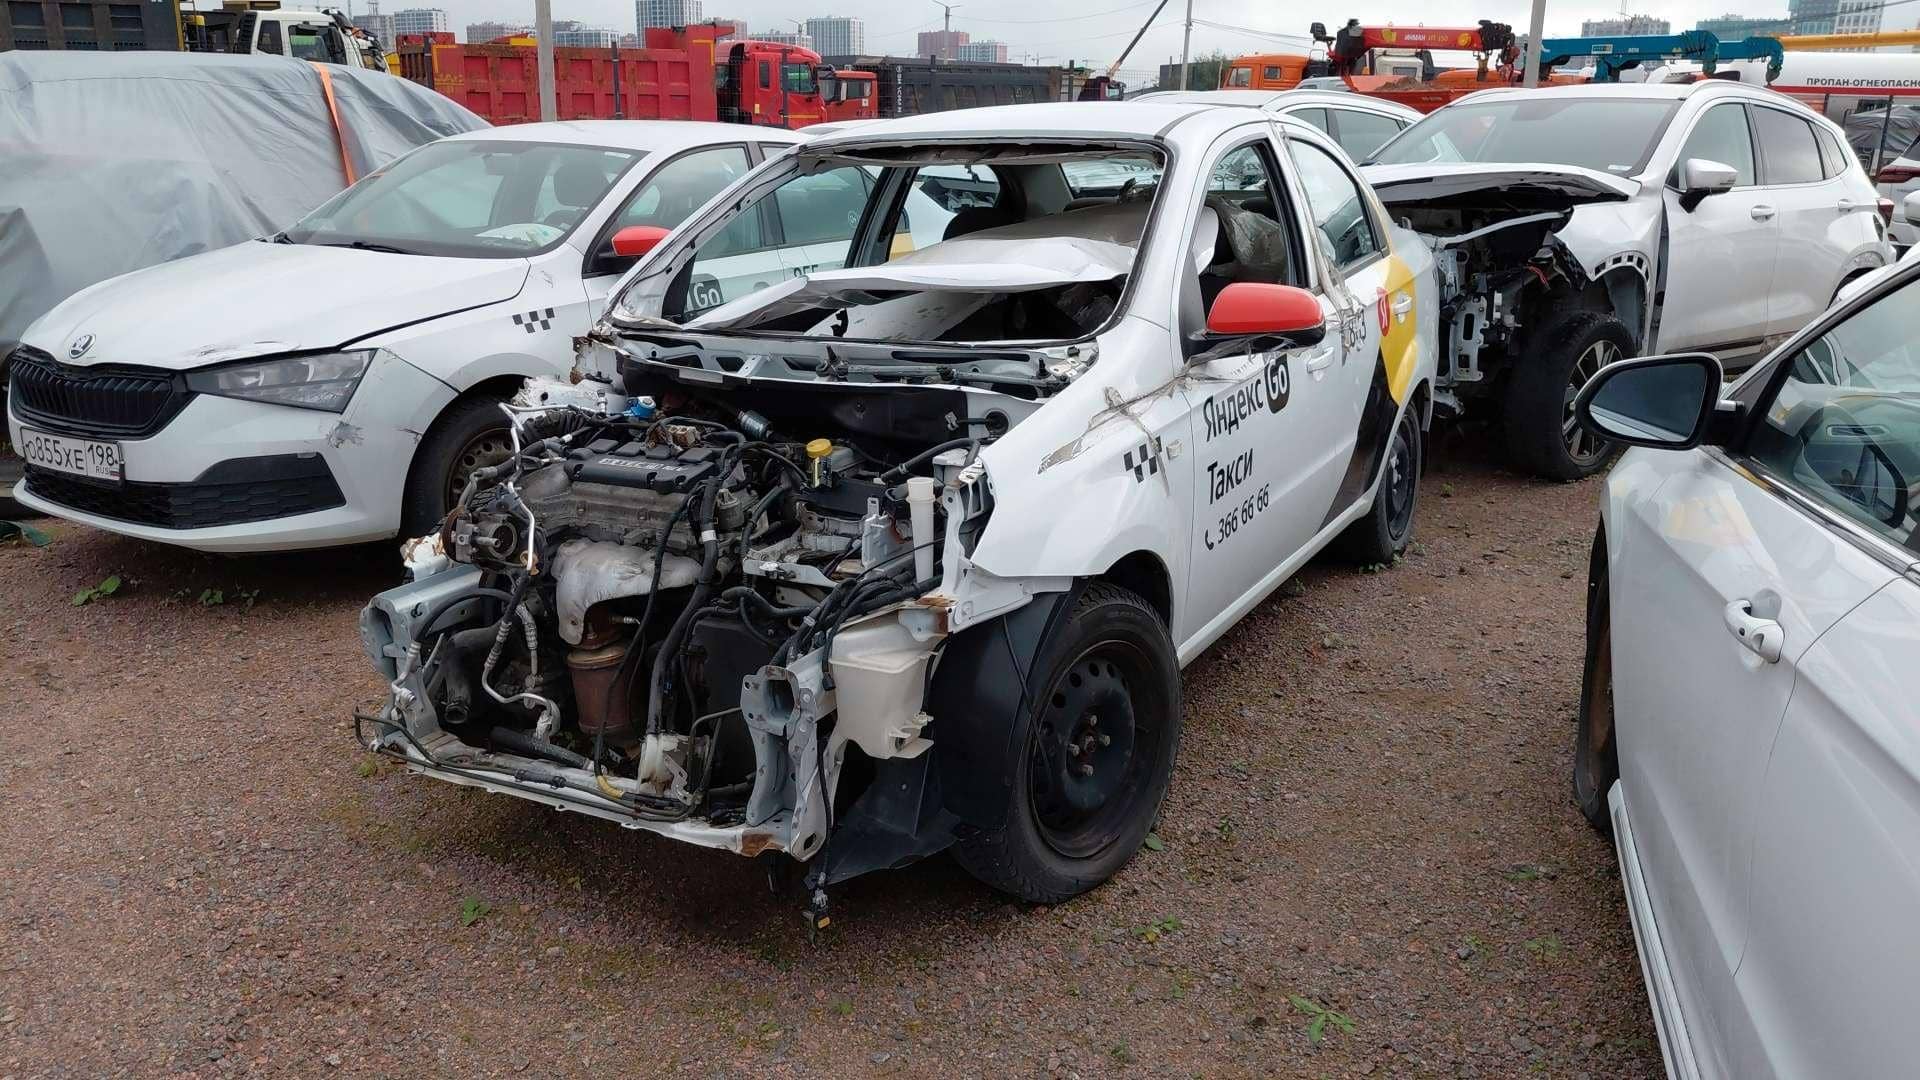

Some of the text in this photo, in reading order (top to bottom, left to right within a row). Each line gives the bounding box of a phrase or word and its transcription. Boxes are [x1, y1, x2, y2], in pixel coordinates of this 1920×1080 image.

[692, 282, 721, 307] Go
[1203, 356, 1289, 442] Яндекс Go
[87, 444, 114, 466] 198
[1207, 448, 1253, 505] Такси
[1218, 483, 1269, 544] 366 66 66
